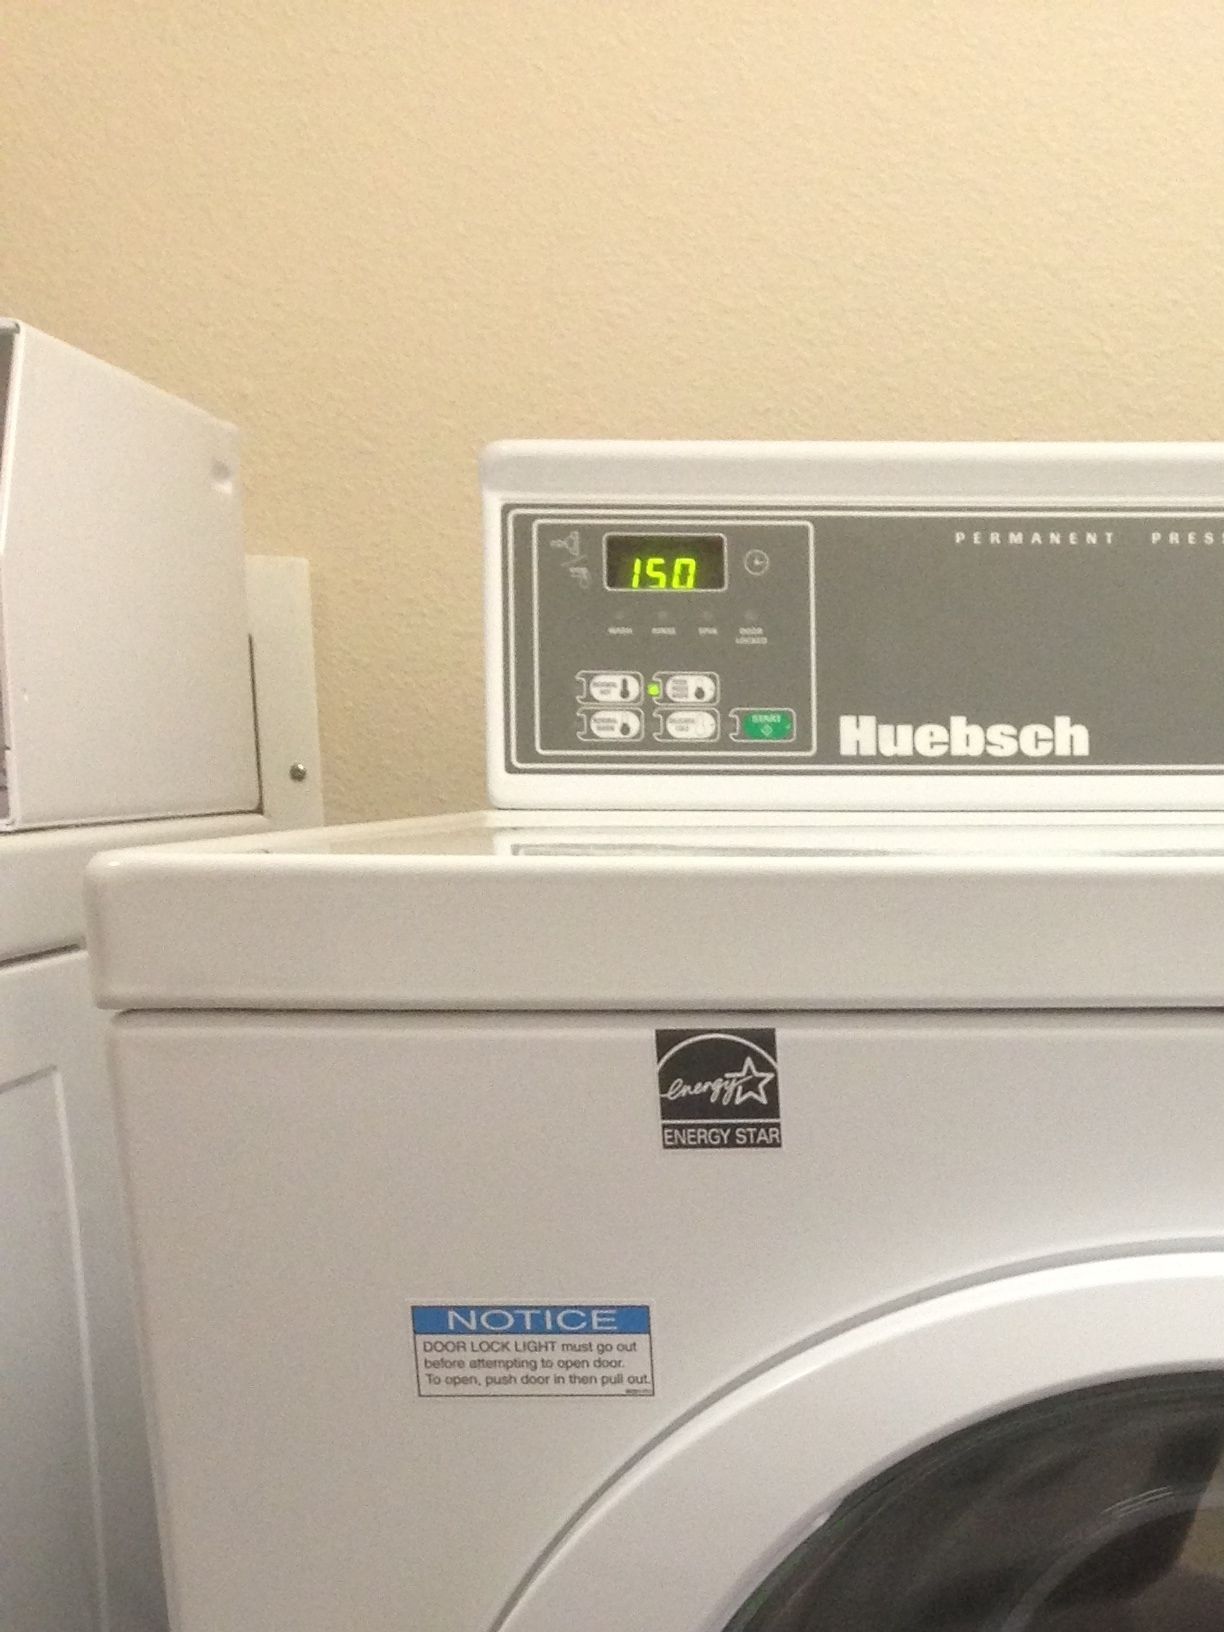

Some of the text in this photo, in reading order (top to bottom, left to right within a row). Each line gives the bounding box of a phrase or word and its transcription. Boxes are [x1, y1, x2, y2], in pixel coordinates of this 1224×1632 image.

[954, 531, 1114, 545] PERMANENT
[628, 557, 701, 590] 150
[839, 714, 1091, 758] Huebsch
[662, 1127, 781, 1146] ENERGY STAR
[447, 1308, 619, 1331] NOTICE
[422, 1339, 637, 1356] DOOR LOCK LIGHT must go out
[423, 1357, 625, 1372] before attempting to open door.
[424, 1372, 651, 1388] To open, push door in then pull out.
